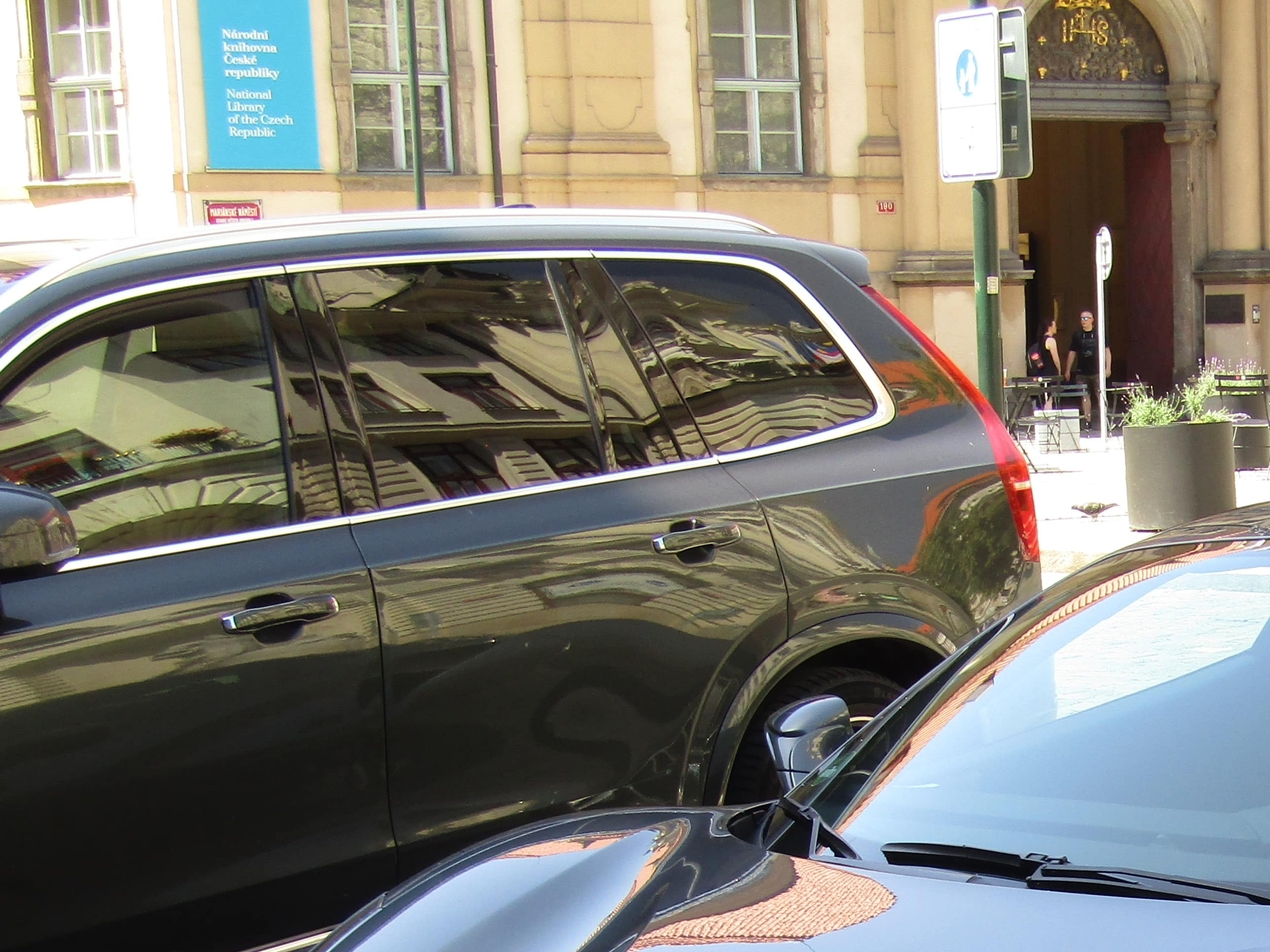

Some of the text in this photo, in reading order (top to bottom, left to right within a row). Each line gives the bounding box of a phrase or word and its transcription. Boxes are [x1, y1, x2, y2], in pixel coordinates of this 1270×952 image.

[222, 28, 270, 41] Národní
[223, 41, 278, 54] knihovna
[223, 52, 258, 65] České
[225, 67, 280, 81] republiky
[226, 88, 273, 100] National
[227, 101, 266, 114] Library
[228, 114, 294, 126] of the Czech
[229, 126, 277, 140] Republic
